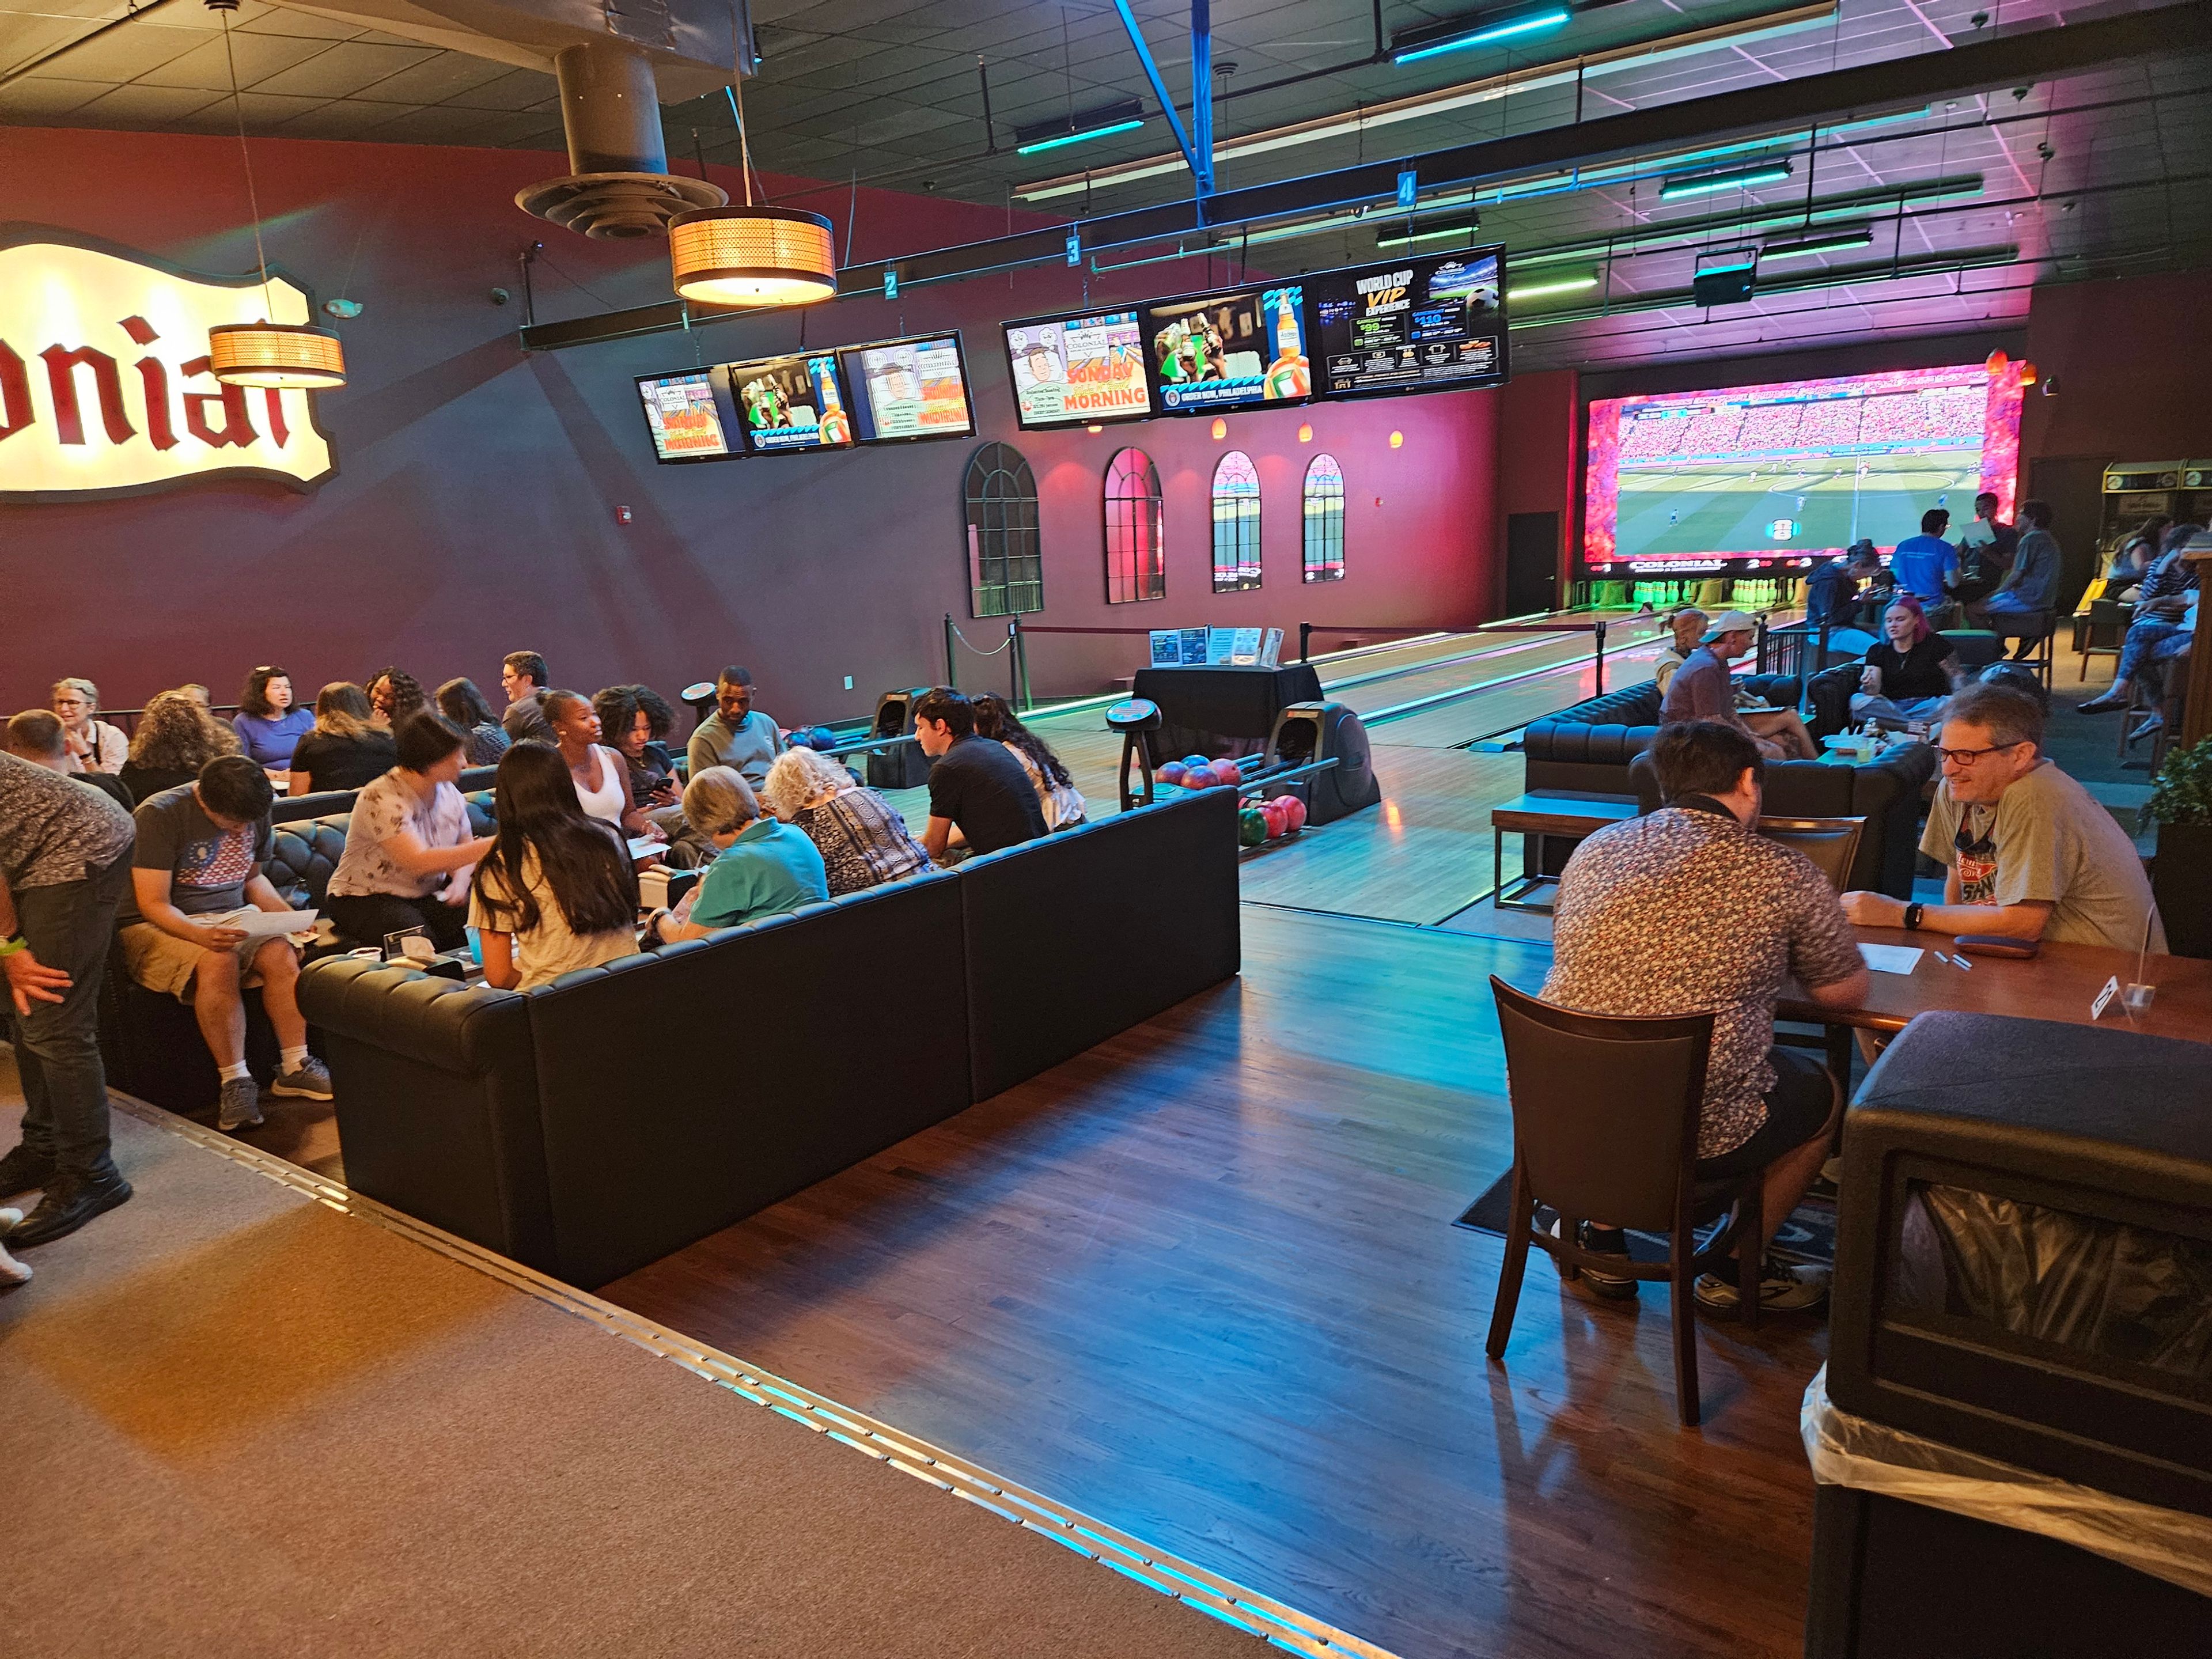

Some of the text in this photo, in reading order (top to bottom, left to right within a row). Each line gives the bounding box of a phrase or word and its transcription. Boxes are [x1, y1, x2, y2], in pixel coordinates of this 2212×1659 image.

[1400, 177, 1414, 202] 4
[1067, 240, 1079, 263] 3
[885, 275, 897, 296] 2
[1356, 274, 1392, 295] WORLD
[1393, 269, 1414, 287] CUP
[1367, 287, 1406, 308] VIP
[1366, 298, 1411, 316] EXPERIENCE
[1360, 323, 1380, 332] $99
[1415, 314, 1442, 325] $110
[1067, 339, 1108, 349] COLONIAL
[1067, 361, 1134, 384] SUNDAY
[0, 315, 290, 449] nia
[1218, 385, 1263, 397] PHILADELPHIA
[1063, 388, 1146, 410] MORNING
[664, 434, 719, 452] MORNING
[1629, 559, 1728, 569] COLONIAL
[1747, 559, 1760, 569] 2
[1799, 558, 1812, 567] 3
